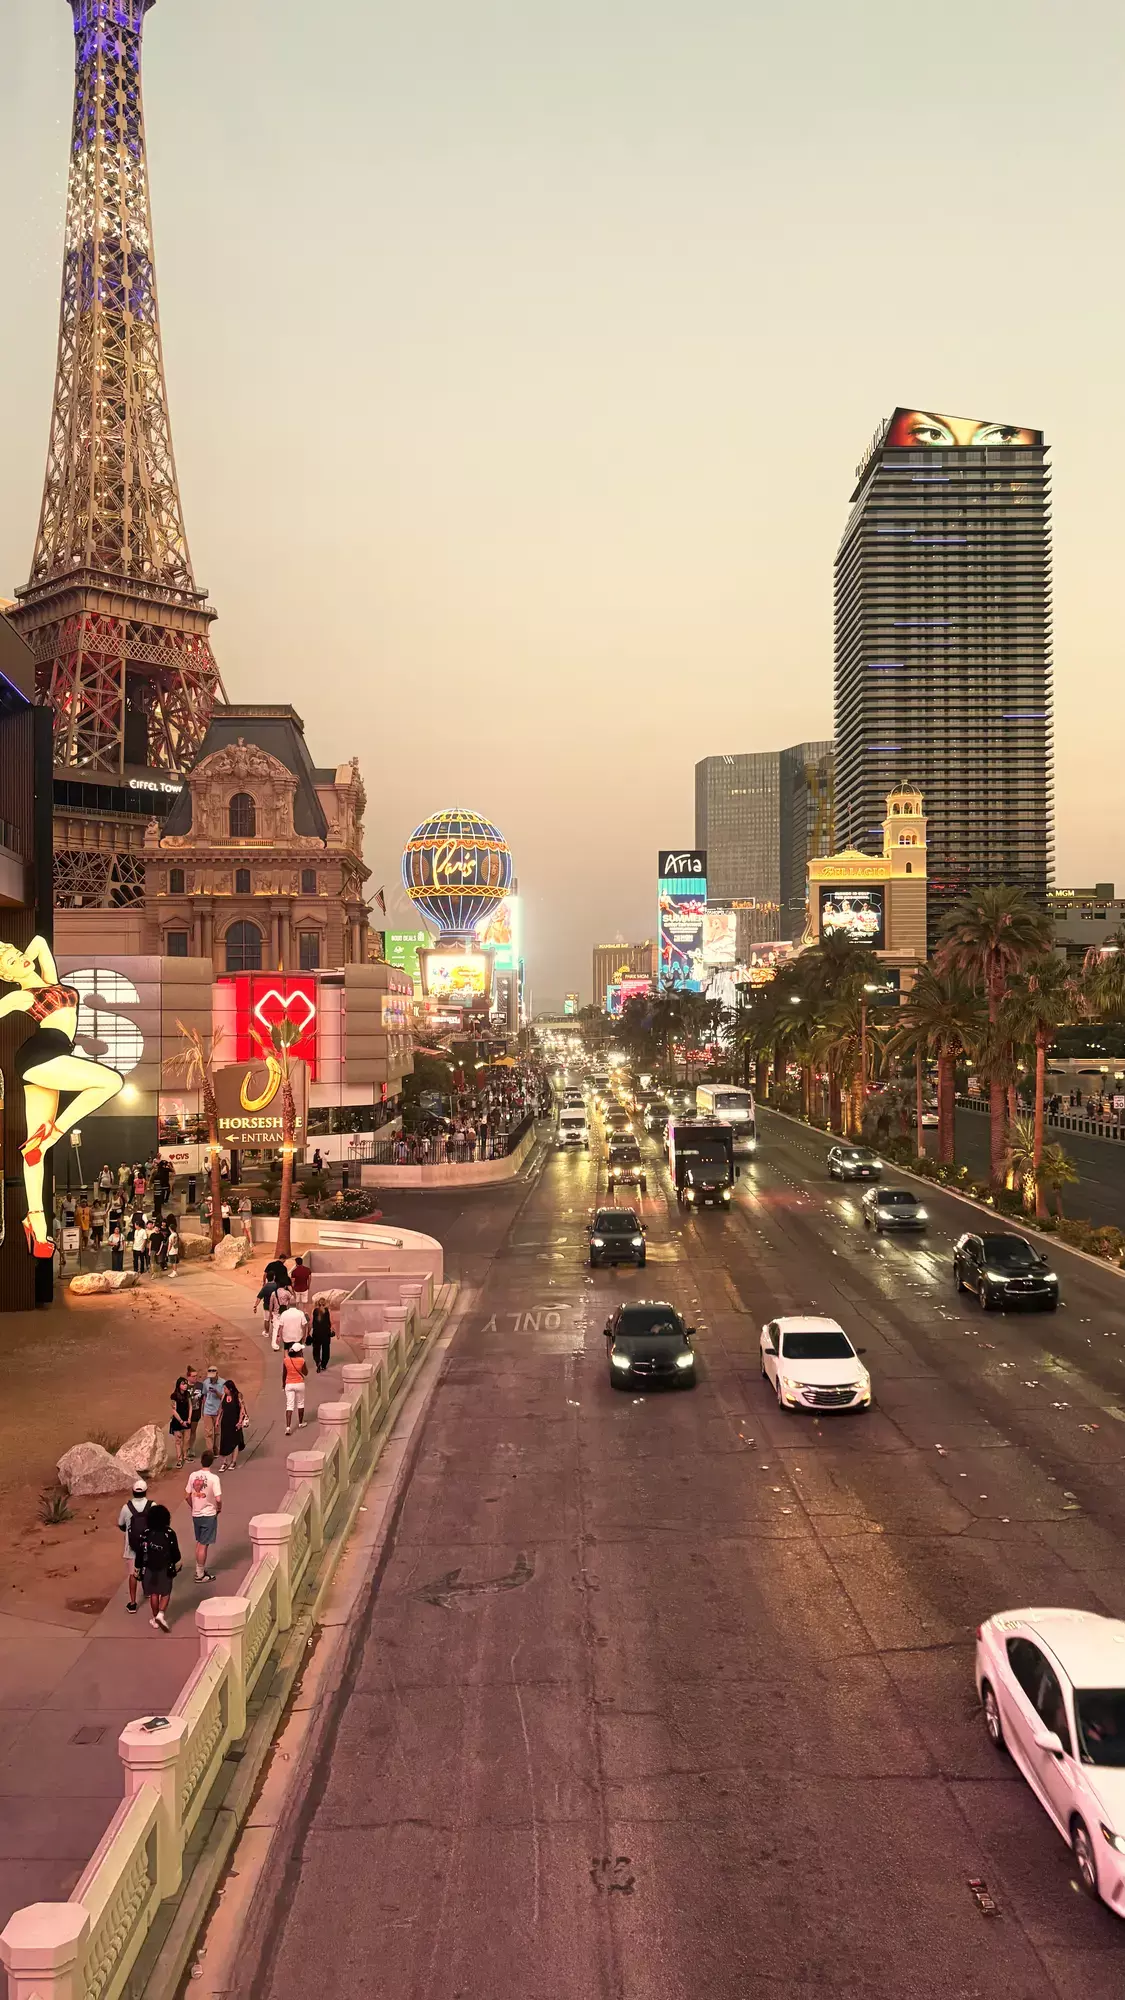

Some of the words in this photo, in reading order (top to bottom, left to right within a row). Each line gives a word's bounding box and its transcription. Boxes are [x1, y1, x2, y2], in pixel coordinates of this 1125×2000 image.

[129, 779, 158, 791] EIFFEL
[432, 838, 477, 890] Paris
[664, 853, 702, 875] Aria
[821, 865, 886, 877] BELLAGIO
[1055, 889, 1075, 897] MGM
[662, 914, 704, 923] SUMMER
[219, 1116, 303, 1129] HORSESHE
[241, 1132, 297, 1143] ENTRANE
[175, 1152, 190, 1160] CVS
[481, 1311, 561, 1332] ONLY
